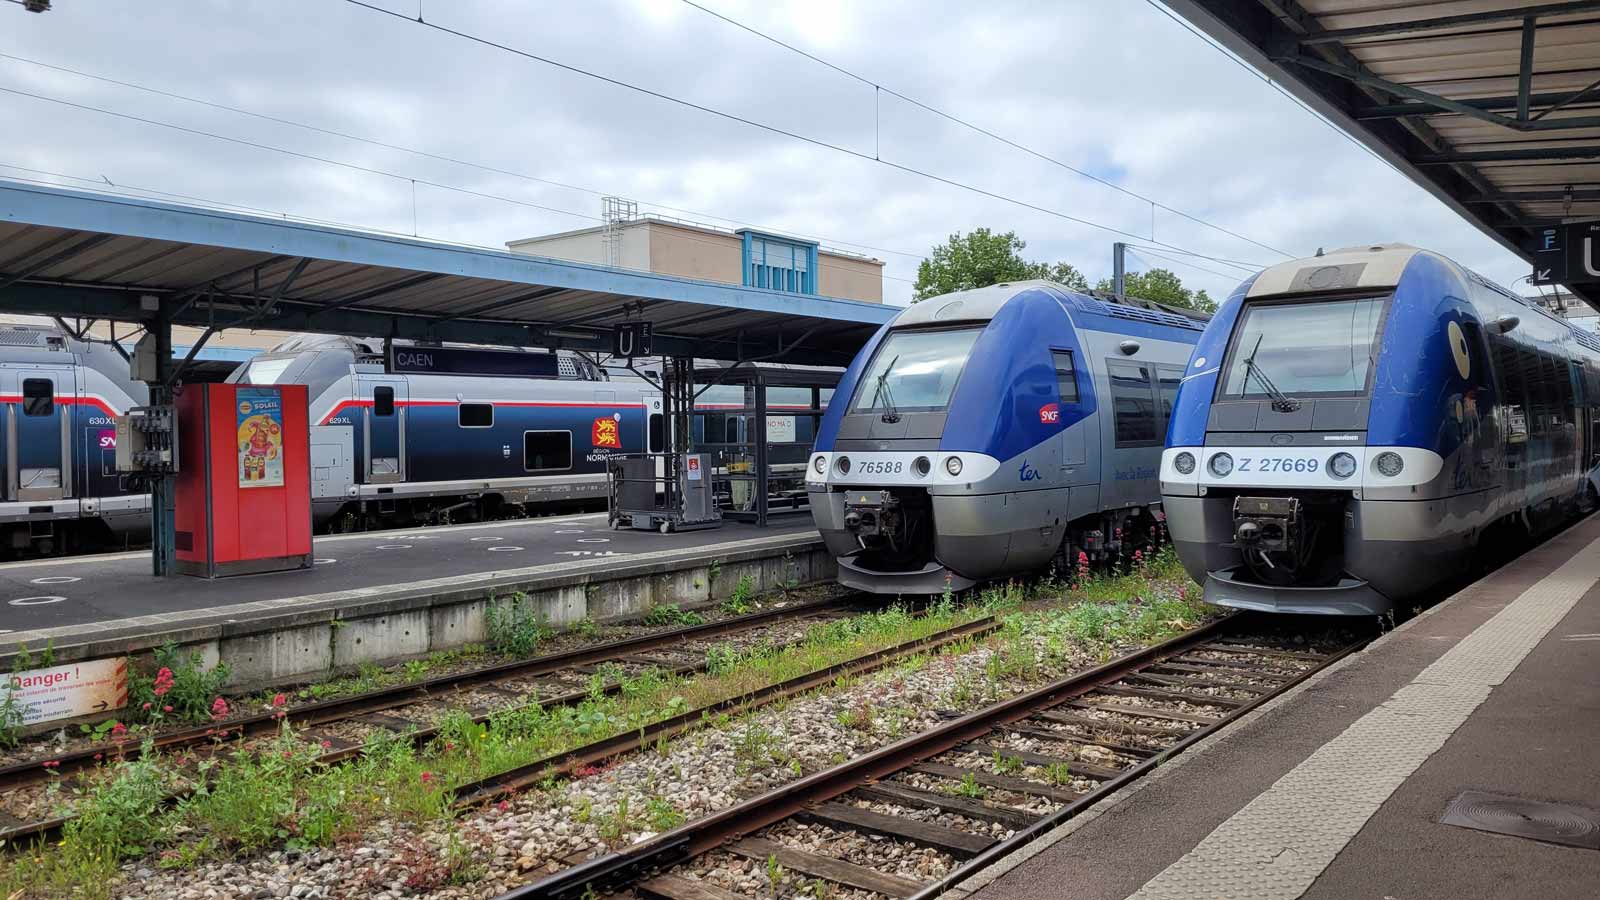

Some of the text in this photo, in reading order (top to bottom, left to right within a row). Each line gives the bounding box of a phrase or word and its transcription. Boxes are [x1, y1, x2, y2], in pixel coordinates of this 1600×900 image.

[620, 331, 633, 356] U
[397, 352, 433, 367] CAEN
[89, 417, 104, 425] 630
[1041, 410, 1059, 421] SNCF
[858, 461, 903, 474] 76588
[1019, 459, 1042, 482] ter
[1238, 458, 1319, 473] Z 27669
